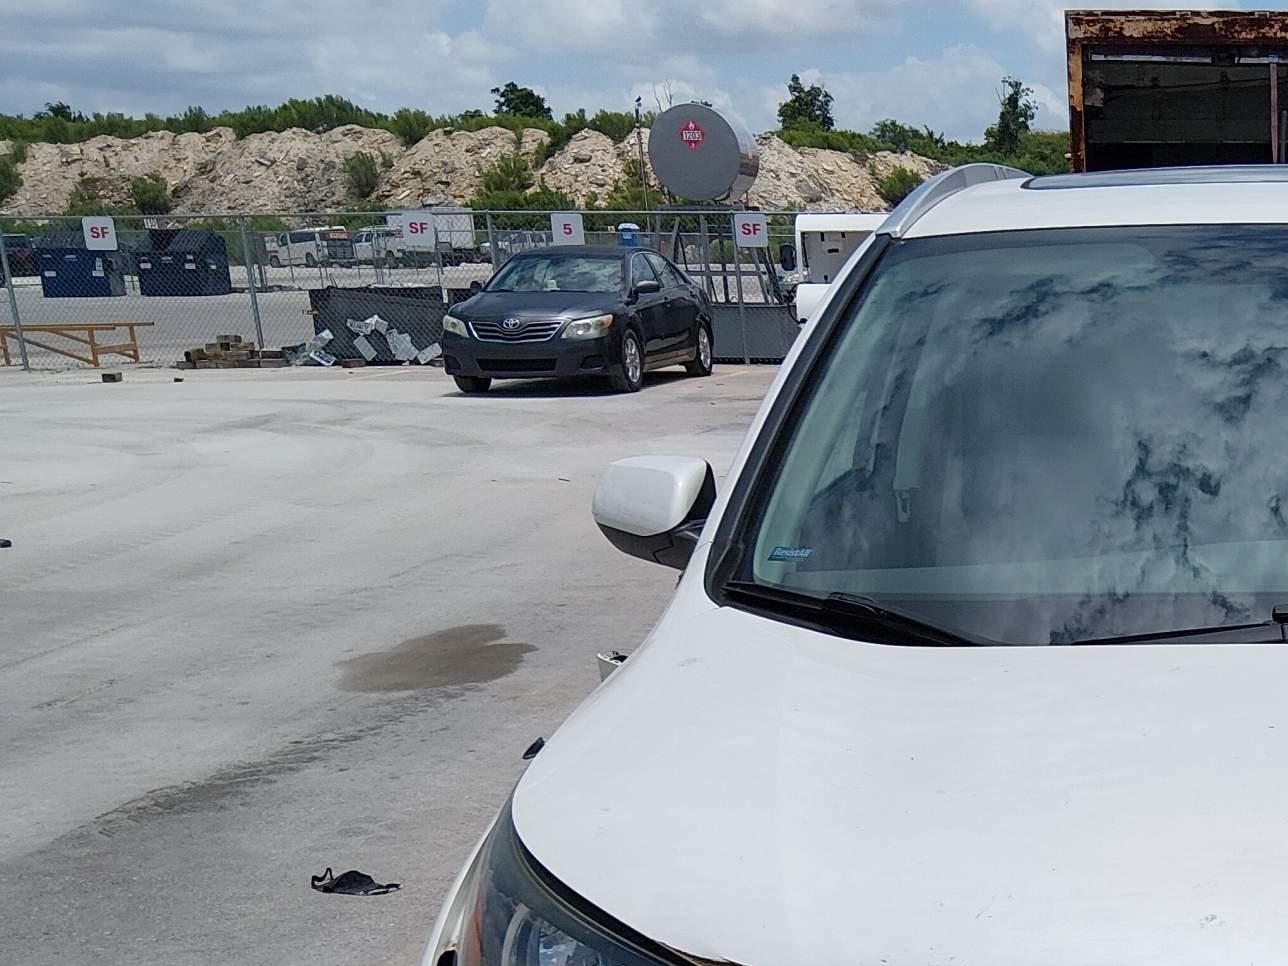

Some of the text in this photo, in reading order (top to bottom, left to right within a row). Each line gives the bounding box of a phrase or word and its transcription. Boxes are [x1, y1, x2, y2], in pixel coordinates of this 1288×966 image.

[683, 131, 701, 140] 1203
[90, 226, 109, 239] SF
[408, 221, 428, 234] SF
[563, 223, 573, 235] 5
[741, 223, 761, 235] SF
